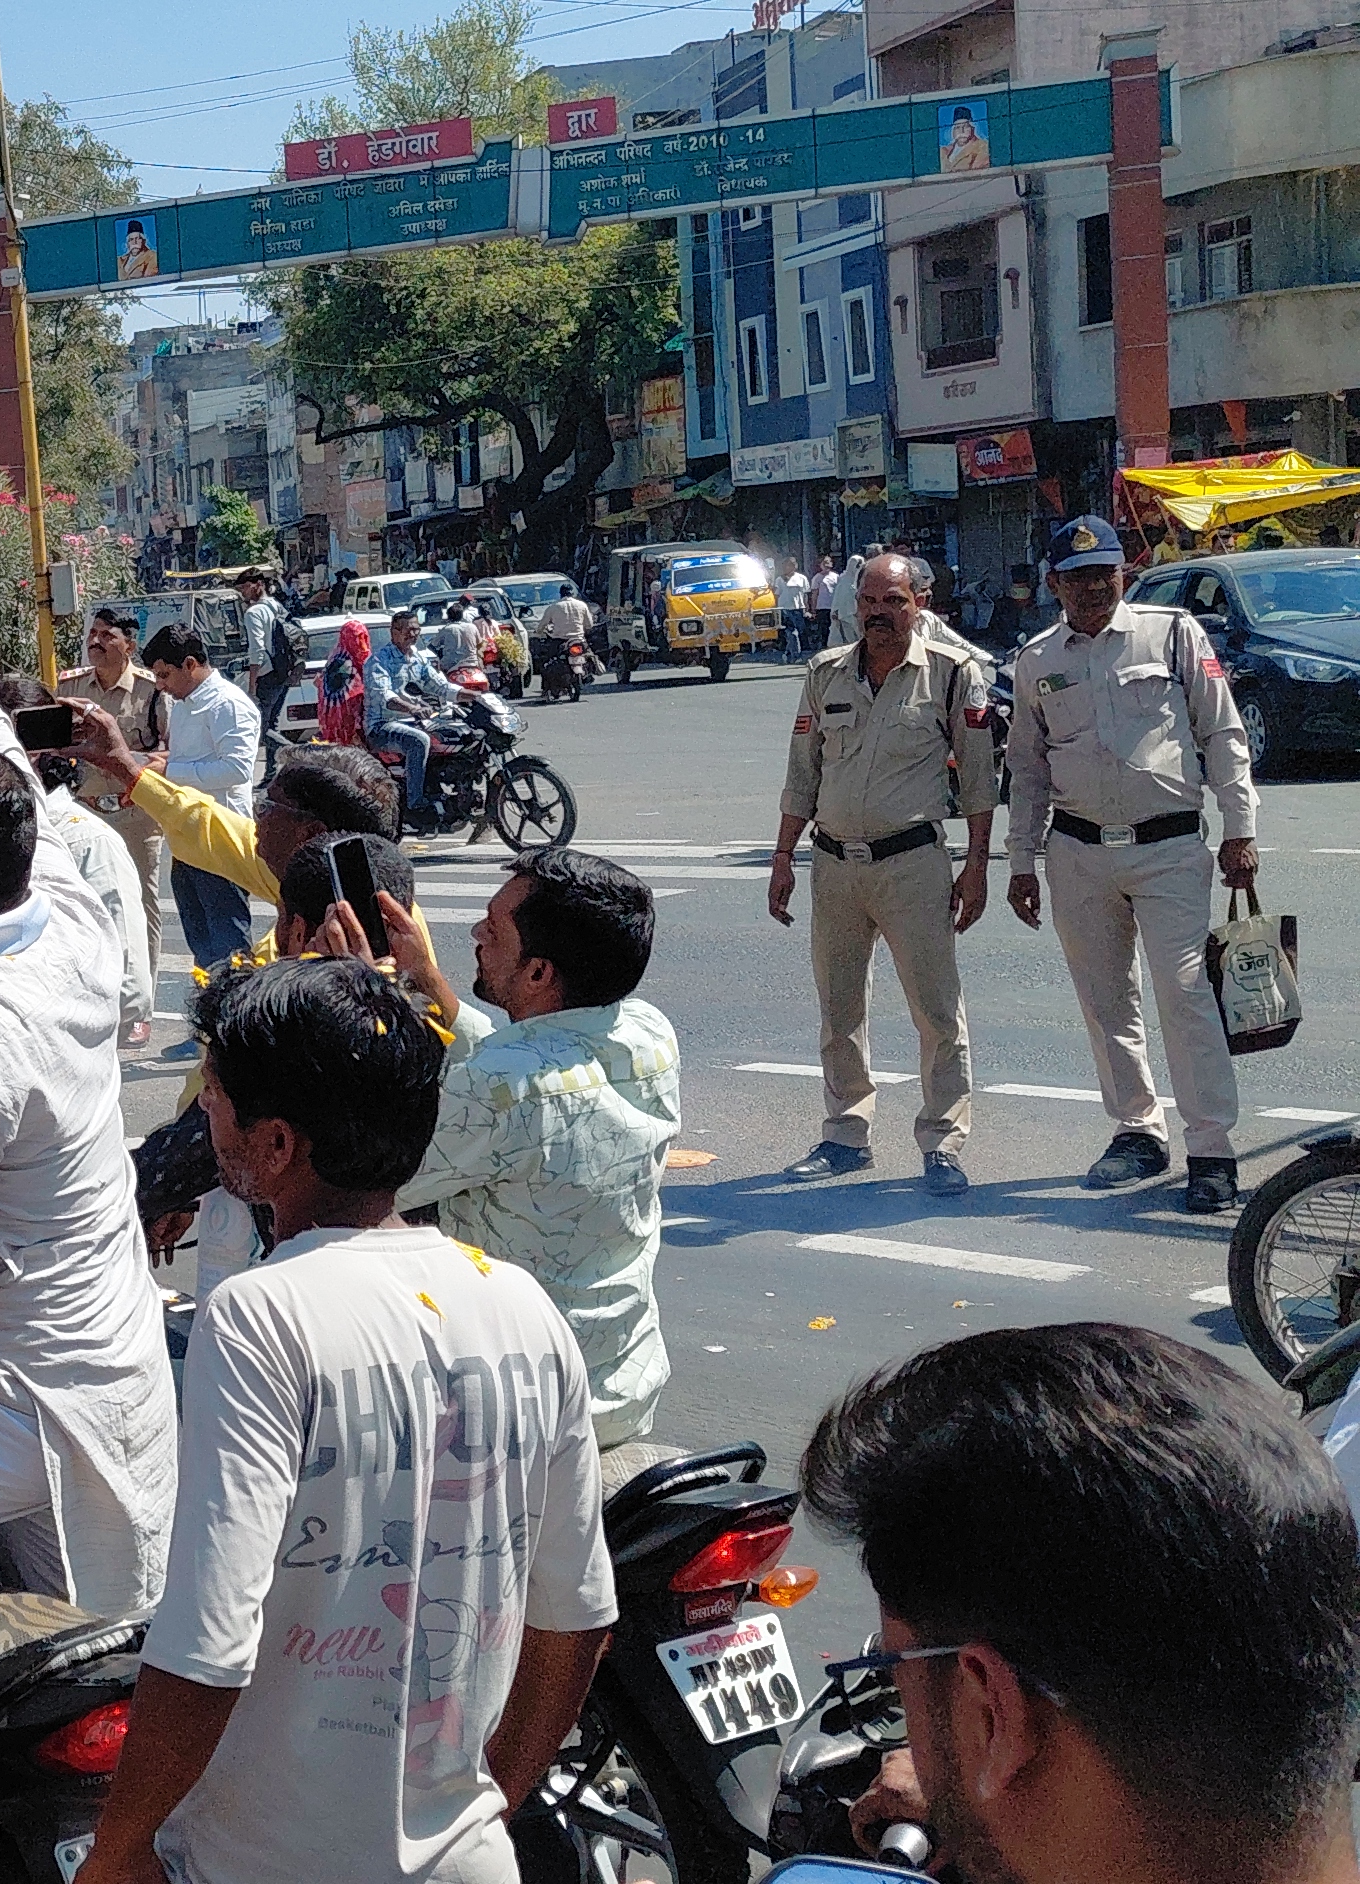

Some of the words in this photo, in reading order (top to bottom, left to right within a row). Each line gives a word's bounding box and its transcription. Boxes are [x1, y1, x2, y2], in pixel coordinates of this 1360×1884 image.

[565, 107, 599, 138] द्वार
[315, 143, 351, 171] डॉ.
[366, 130, 440, 166] हेडगेवार
[552, 148, 607, 171] अभिनन्दन
[615, 141, 653, 163] परिषद
[579, 173, 618, 192] अशोक
[621, 167, 647, 187] शर्मा
[250, 197, 272, 212] नगर
[281, 188, 323, 207] पालिका
[389, 200, 424, 217] अनिल
[282, 1623, 384, 1665] new
[337, 1665, 385, 1682] Rabbit
[700, 1673, 799, 1741] 1449
